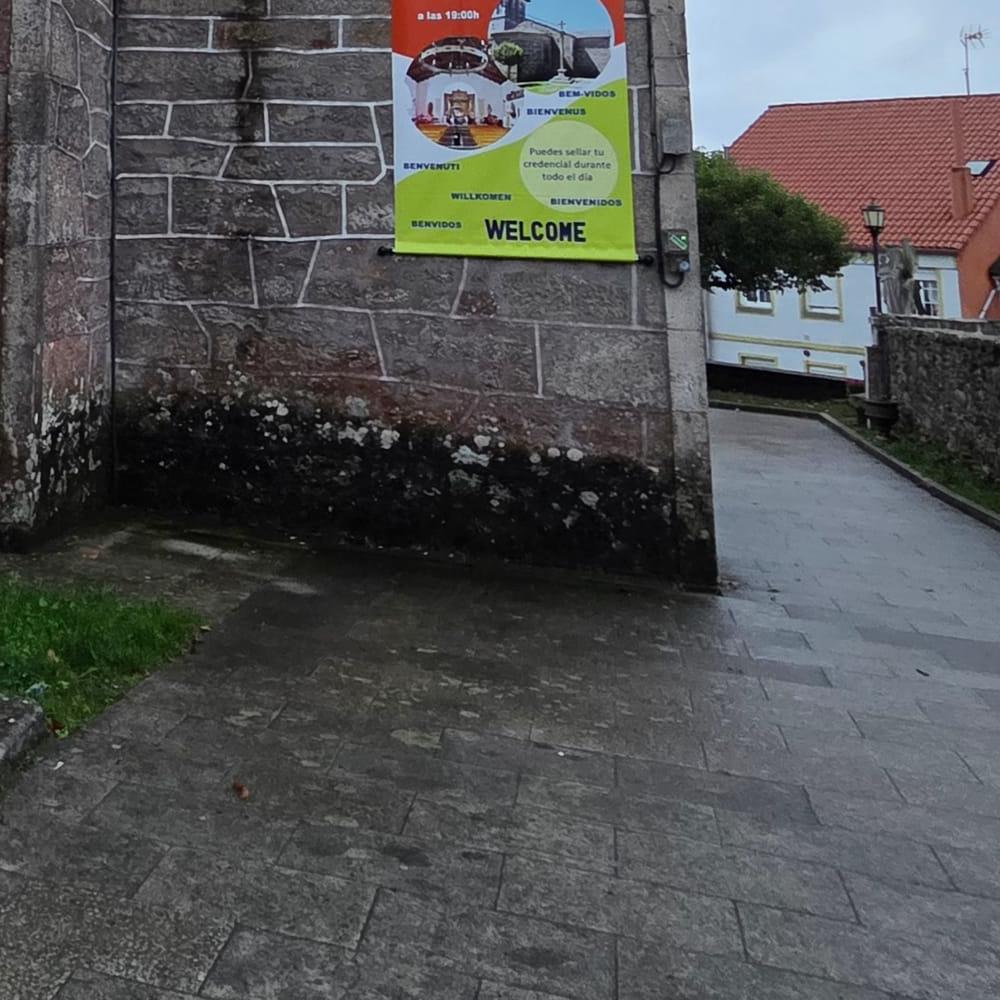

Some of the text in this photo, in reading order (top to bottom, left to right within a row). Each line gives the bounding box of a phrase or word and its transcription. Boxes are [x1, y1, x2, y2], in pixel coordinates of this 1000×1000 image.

[417, 10, 479, 20] a las 19:00h
[558, 90, 616, 98] BEM-VIDOS
[526, 108, 586, 116] BIENVENUS
[529, 148, 562, 156] Puedes
[566, 148, 591, 156] sellar
[403, 162, 460, 171] BENVENUTI
[523, 160, 611, 169] credencial durante
[542, 173, 564, 181] todo
[566, 173, 576, 181] el
[451, 192, 511, 201] WILLKOMEN
[550, 198, 622, 207] BIENVENIDOS
[411, 220, 462, 229] BENVIDOS
[484, 218, 587, 242] WELCOME
